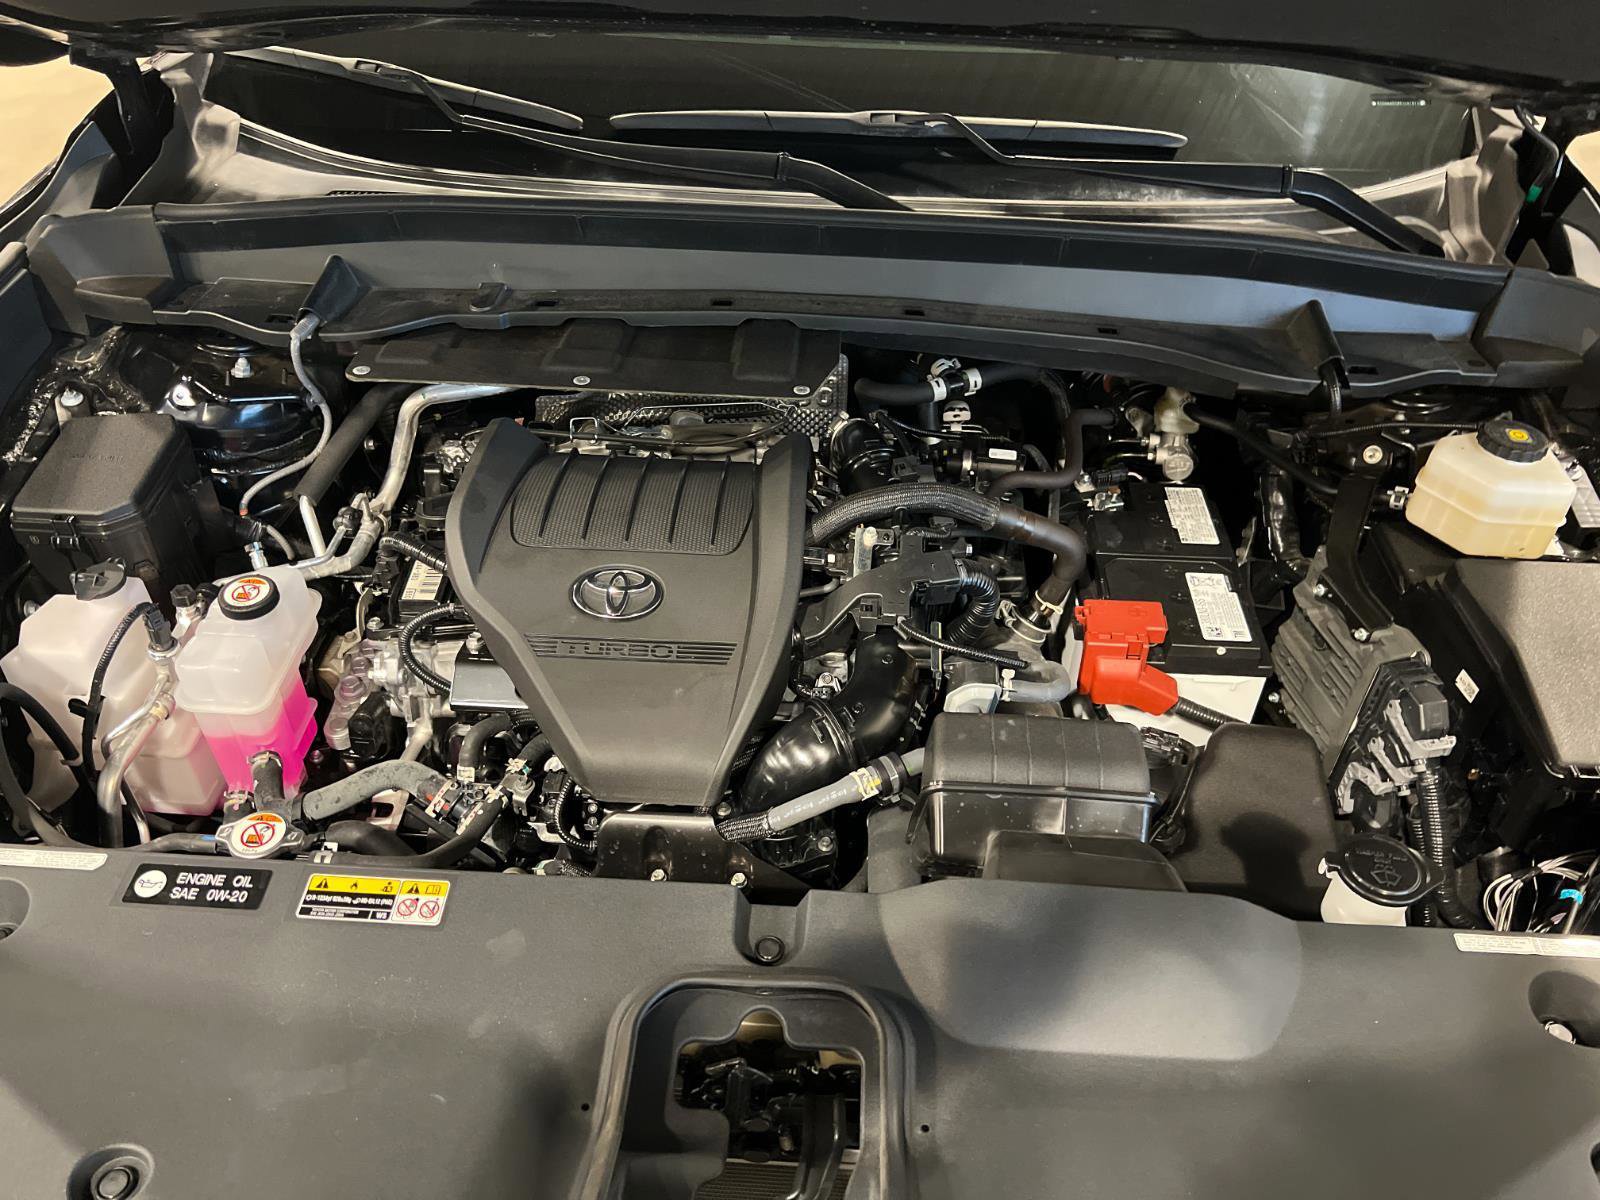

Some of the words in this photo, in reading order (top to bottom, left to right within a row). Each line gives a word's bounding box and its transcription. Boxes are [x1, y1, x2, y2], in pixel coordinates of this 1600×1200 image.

[561, 640, 674, 659] TURBO
[176, 872, 226, 886] ENGINE
[232, 875, 254, 888] OIL
[169, 886, 199, 900] SAE
[206, 888, 248, 903] 0W-20
